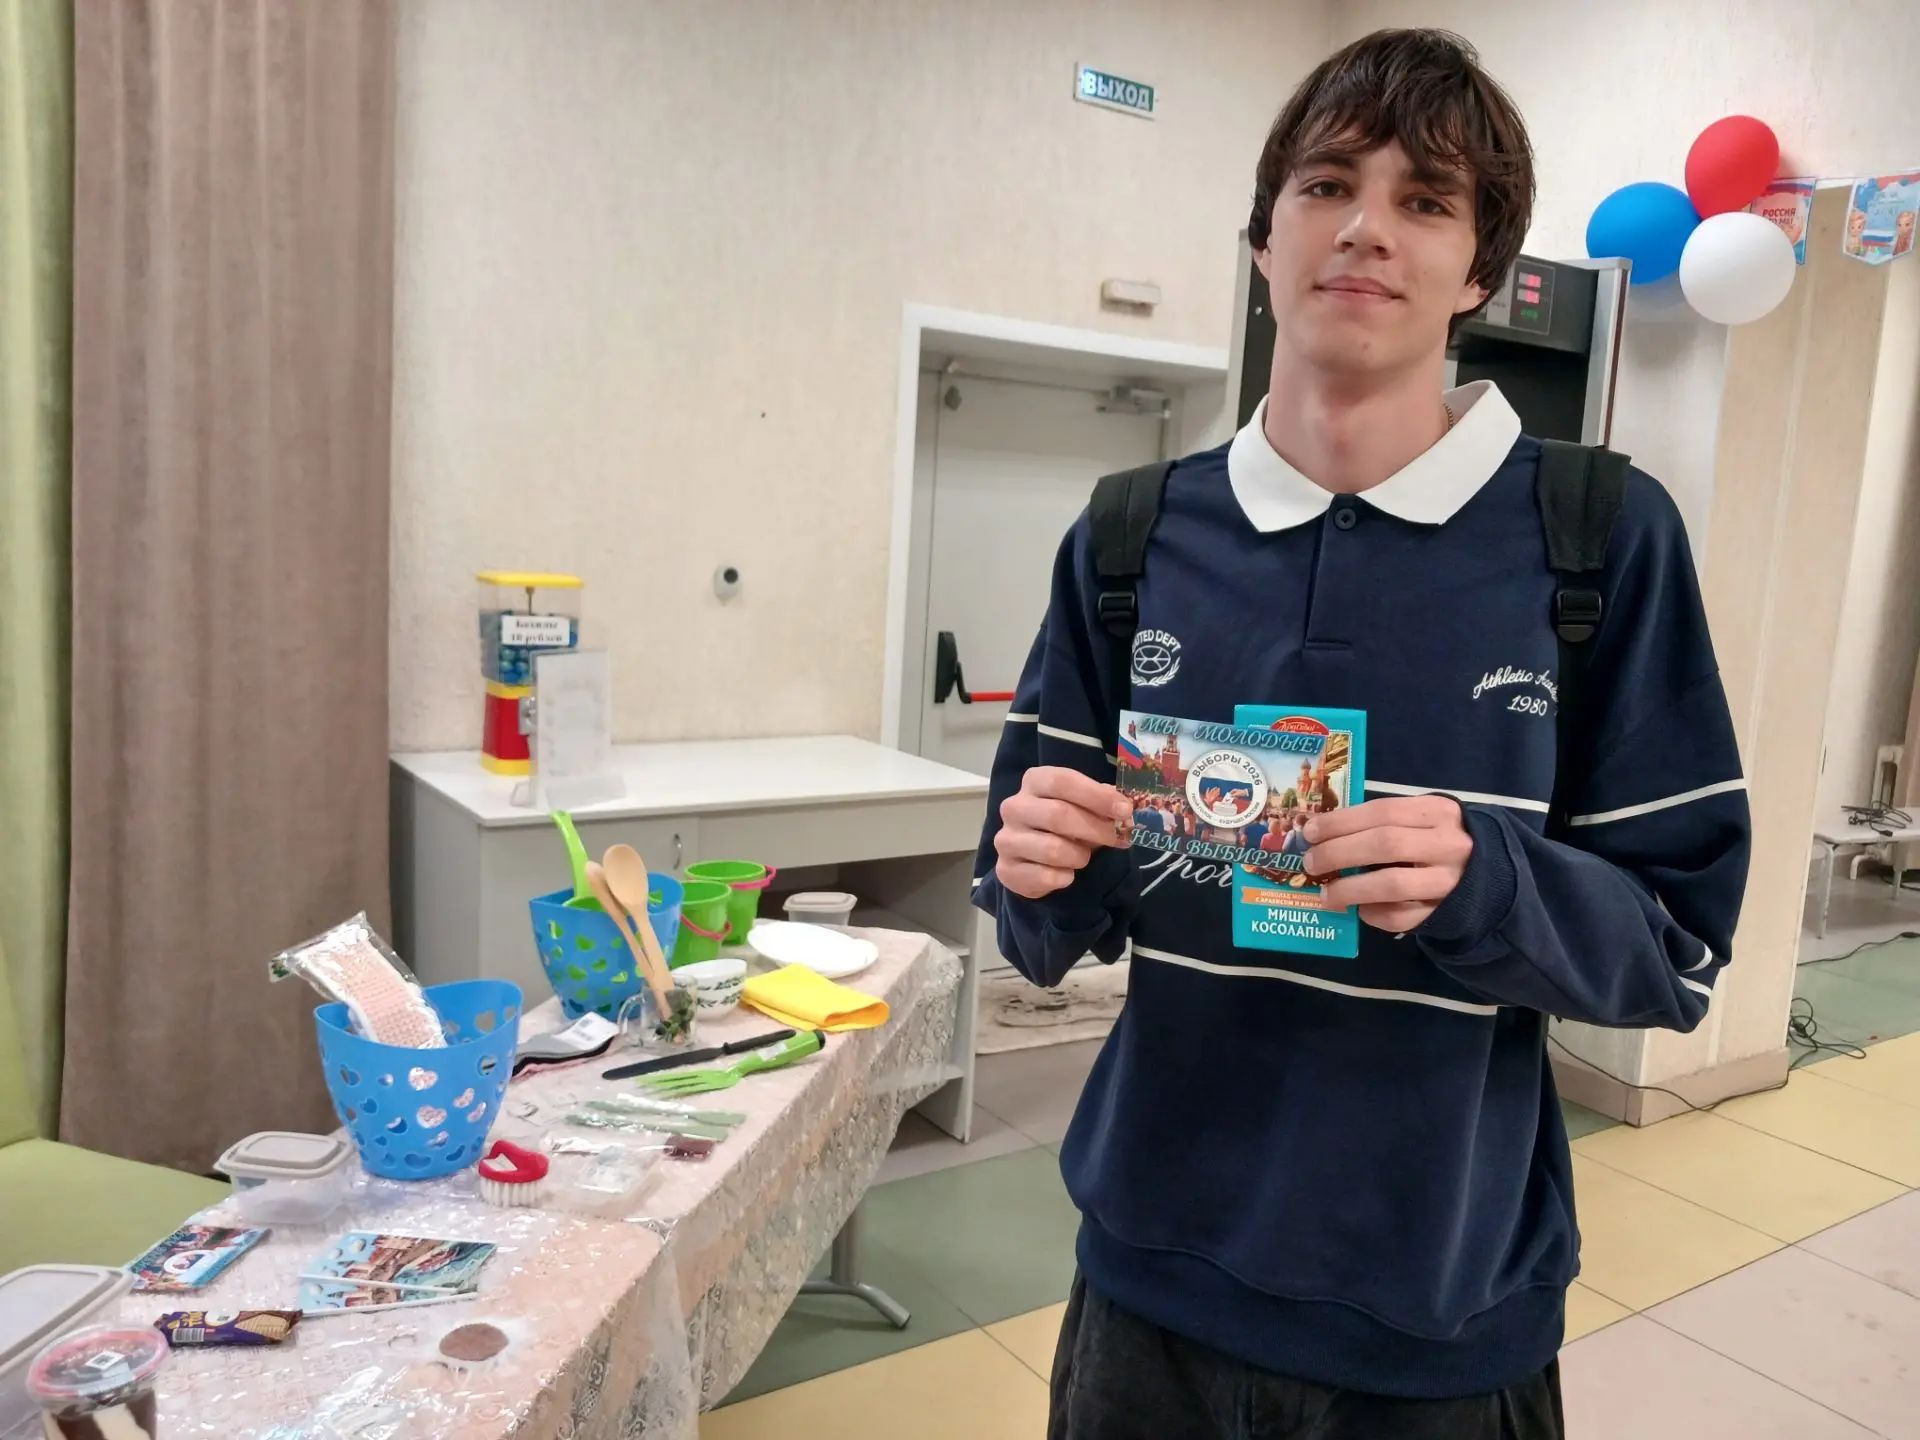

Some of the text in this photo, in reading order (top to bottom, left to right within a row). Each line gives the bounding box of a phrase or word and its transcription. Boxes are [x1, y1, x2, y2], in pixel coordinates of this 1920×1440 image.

[1083, 71, 1151, 110] ВЫХОД
[1762, 207, 1797, 217] РОССИЯ
[1155, 629, 1182, 653] DEPT
[1472, 665, 1534, 700] Athletic
[1507, 695, 1548, 716] 1980
[1139, 716, 1323, 754] МЫ МОЛОДЫЕ!
[1192, 753, 1263, 786] ВЫБОРЫ 2026
[1130, 828, 1304, 872] НАМ ВЫБИРАТ
[1251, 920, 1336, 941] КОСОЛАПЫЙ
[1268, 908, 1320, 925] МИШКА
